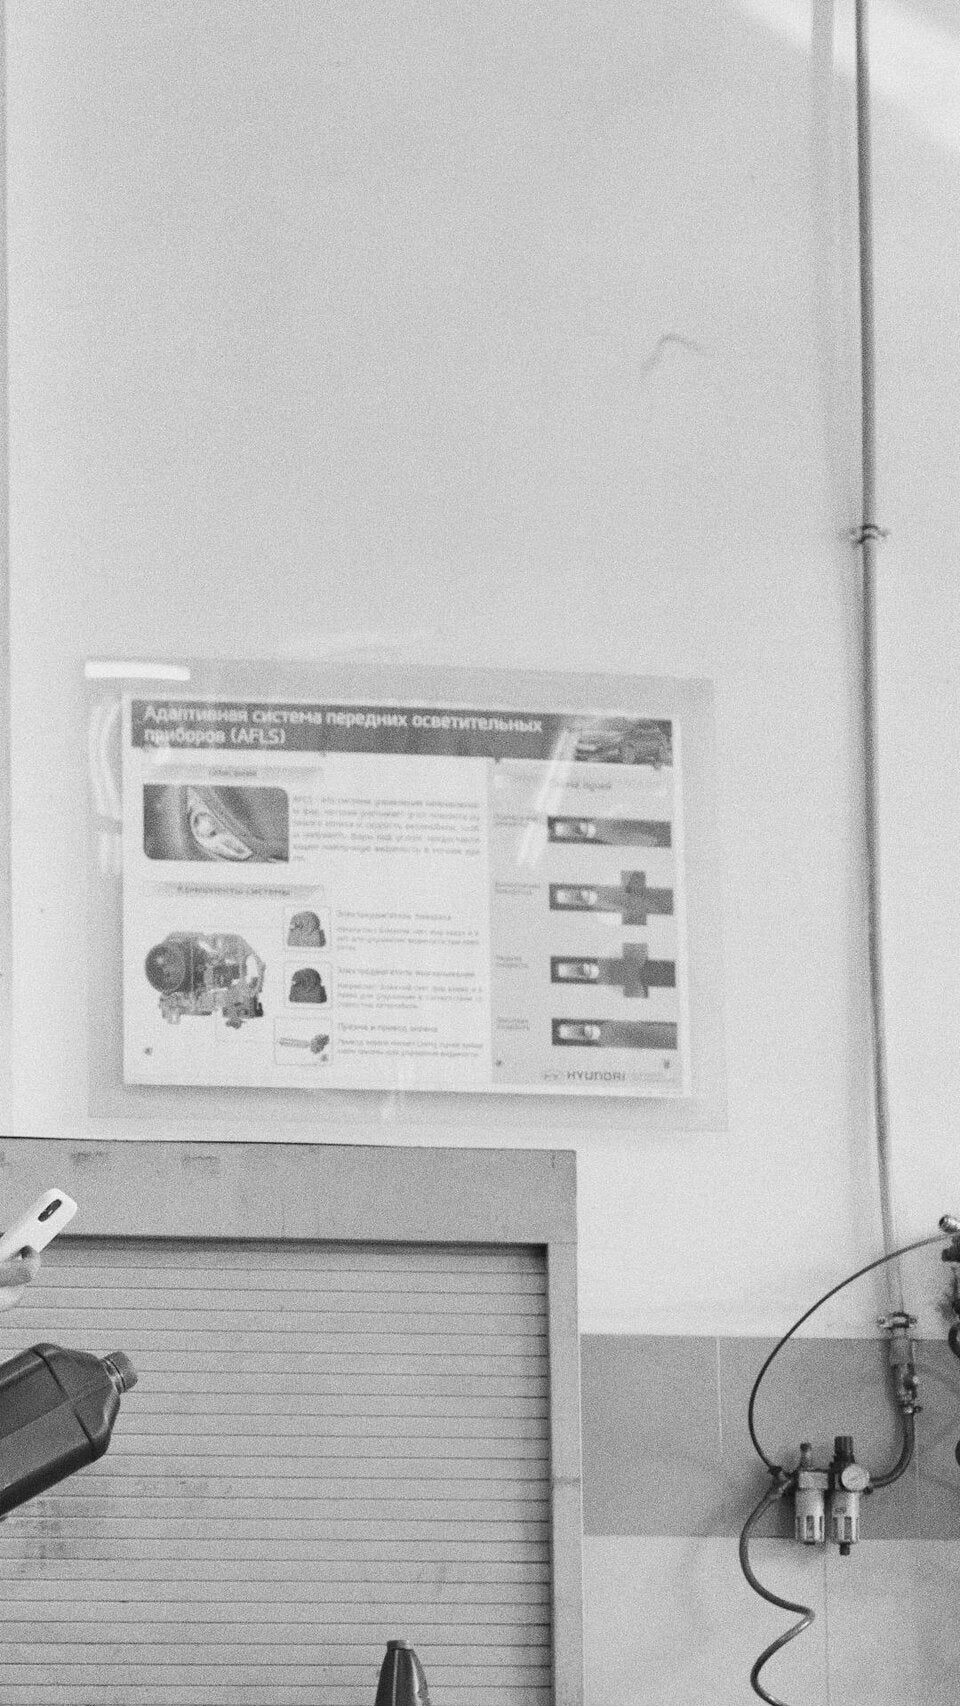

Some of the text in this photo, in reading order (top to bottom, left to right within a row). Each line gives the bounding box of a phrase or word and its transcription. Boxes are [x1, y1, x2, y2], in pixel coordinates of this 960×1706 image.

[143, 705, 543, 733] Адаптивная система передних осветительных
[143, 727, 286, 745] приборов (AFLS)
[566, 1070, 626, 1082] HYUNDAI
